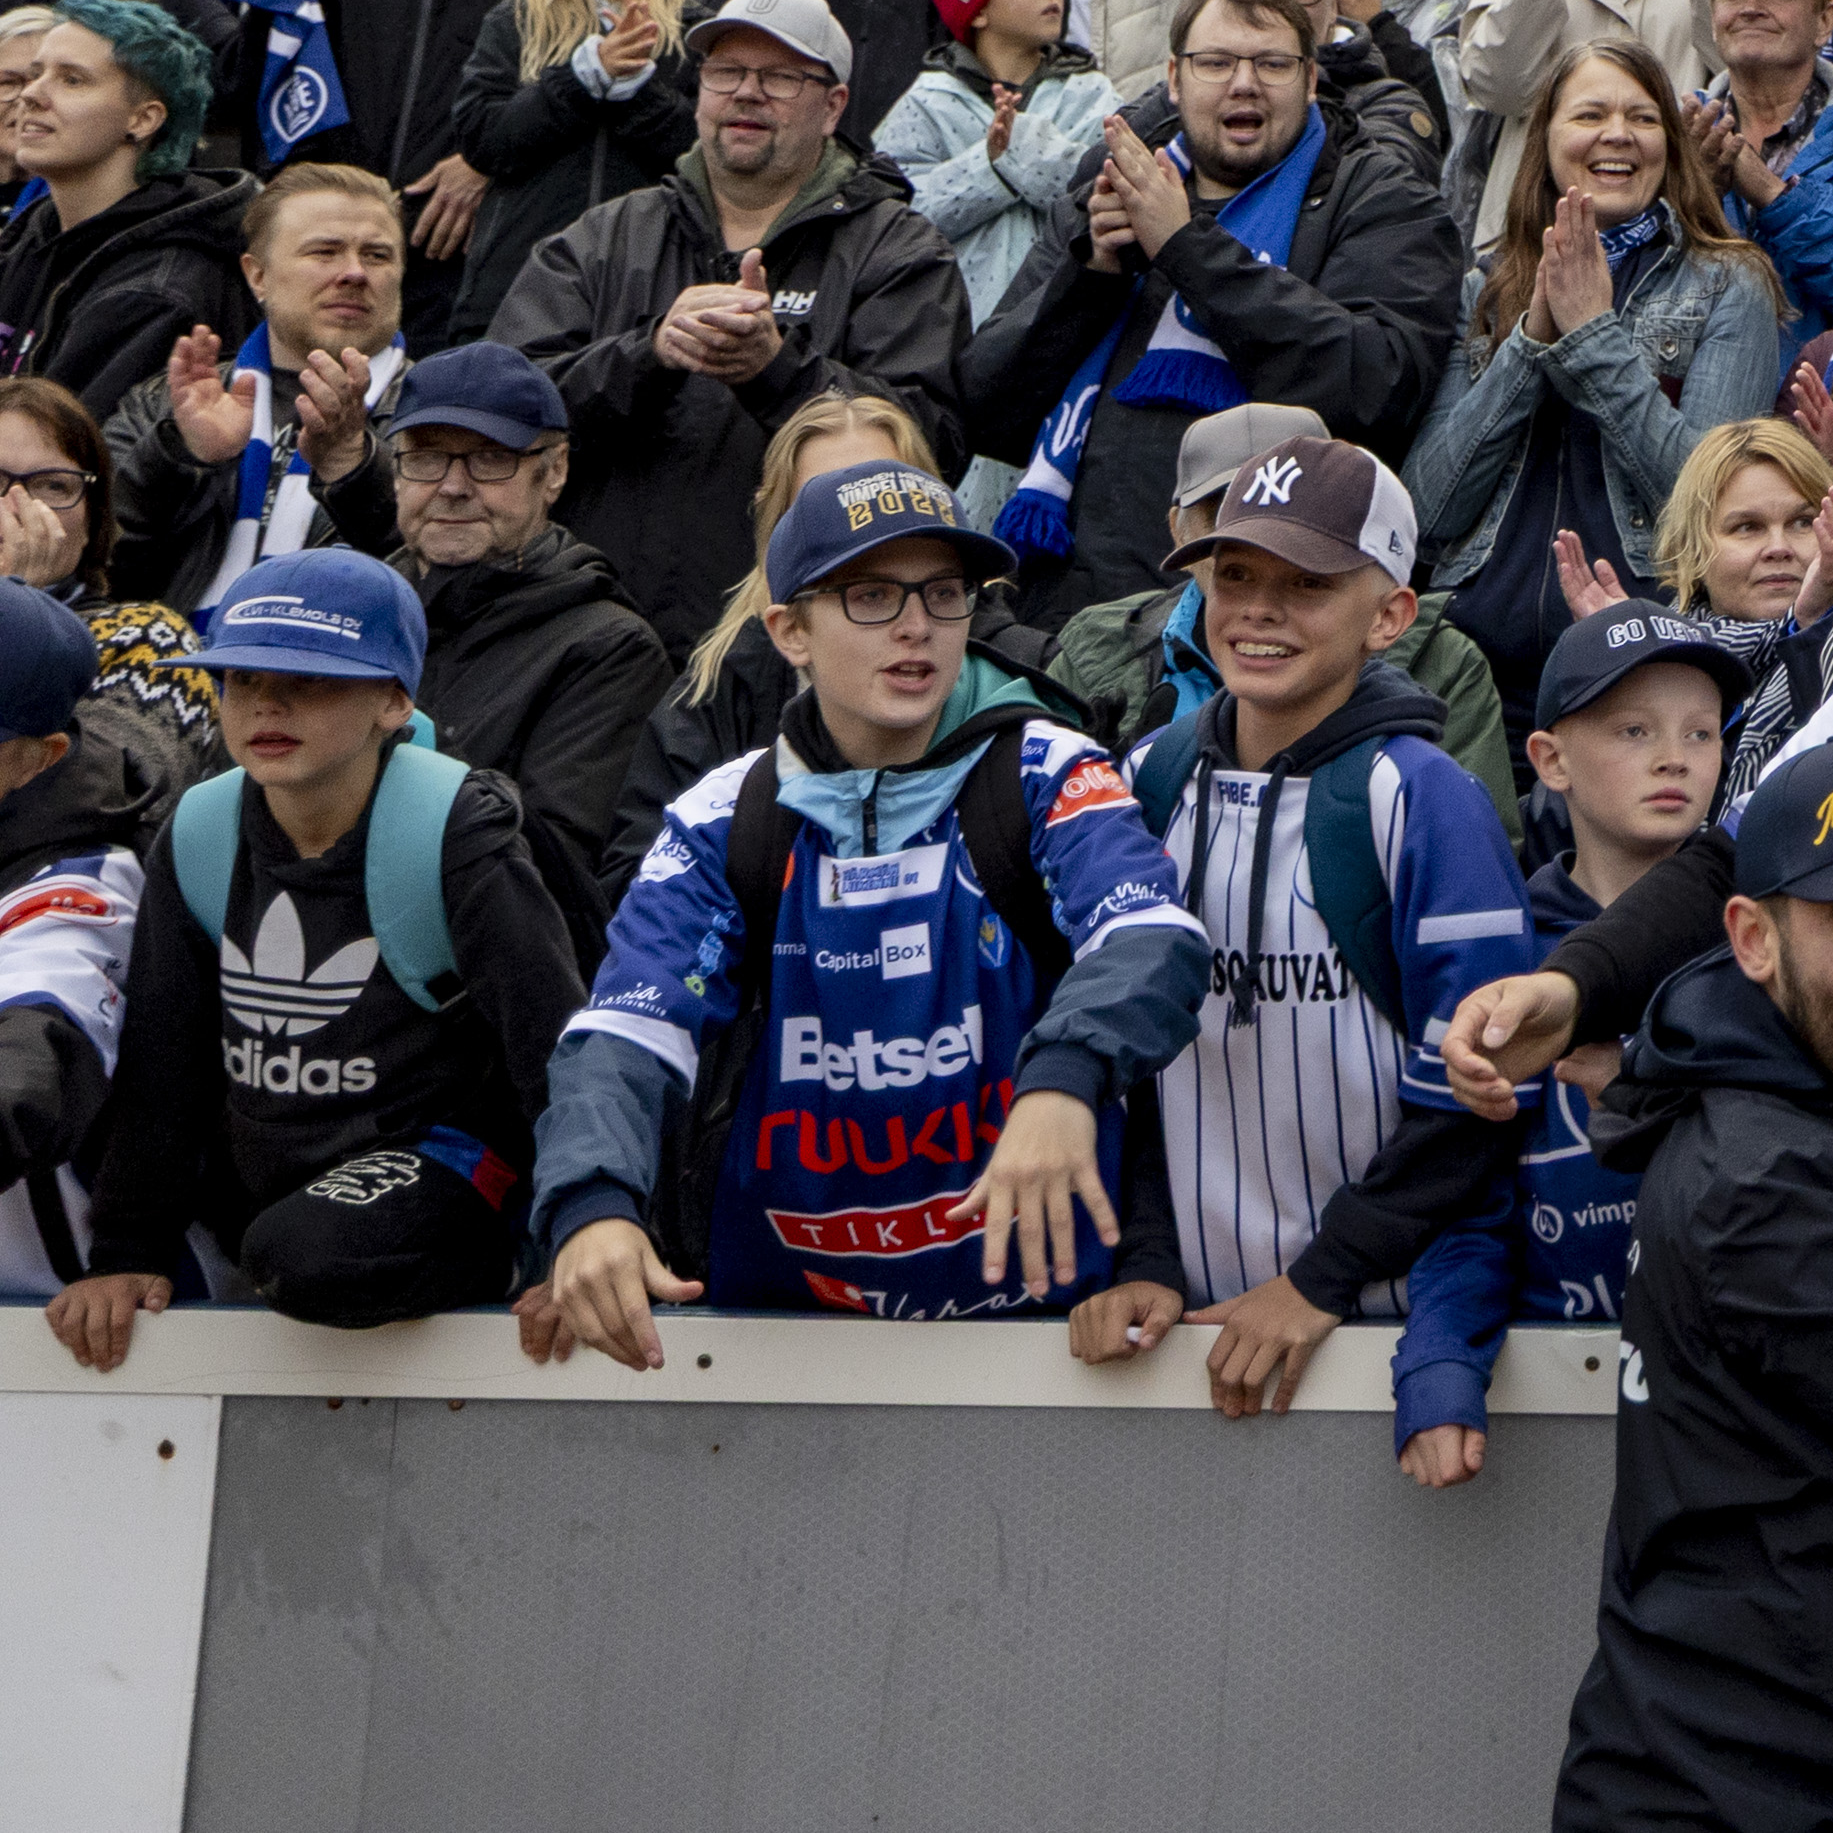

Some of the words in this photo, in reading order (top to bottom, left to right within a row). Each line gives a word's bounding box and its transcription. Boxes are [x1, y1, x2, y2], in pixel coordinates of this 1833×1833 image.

[771, 290, 818, 314] HH
[1242, 455, 1304, 506] NY
[780, 1005, 984, 1090] Betset
